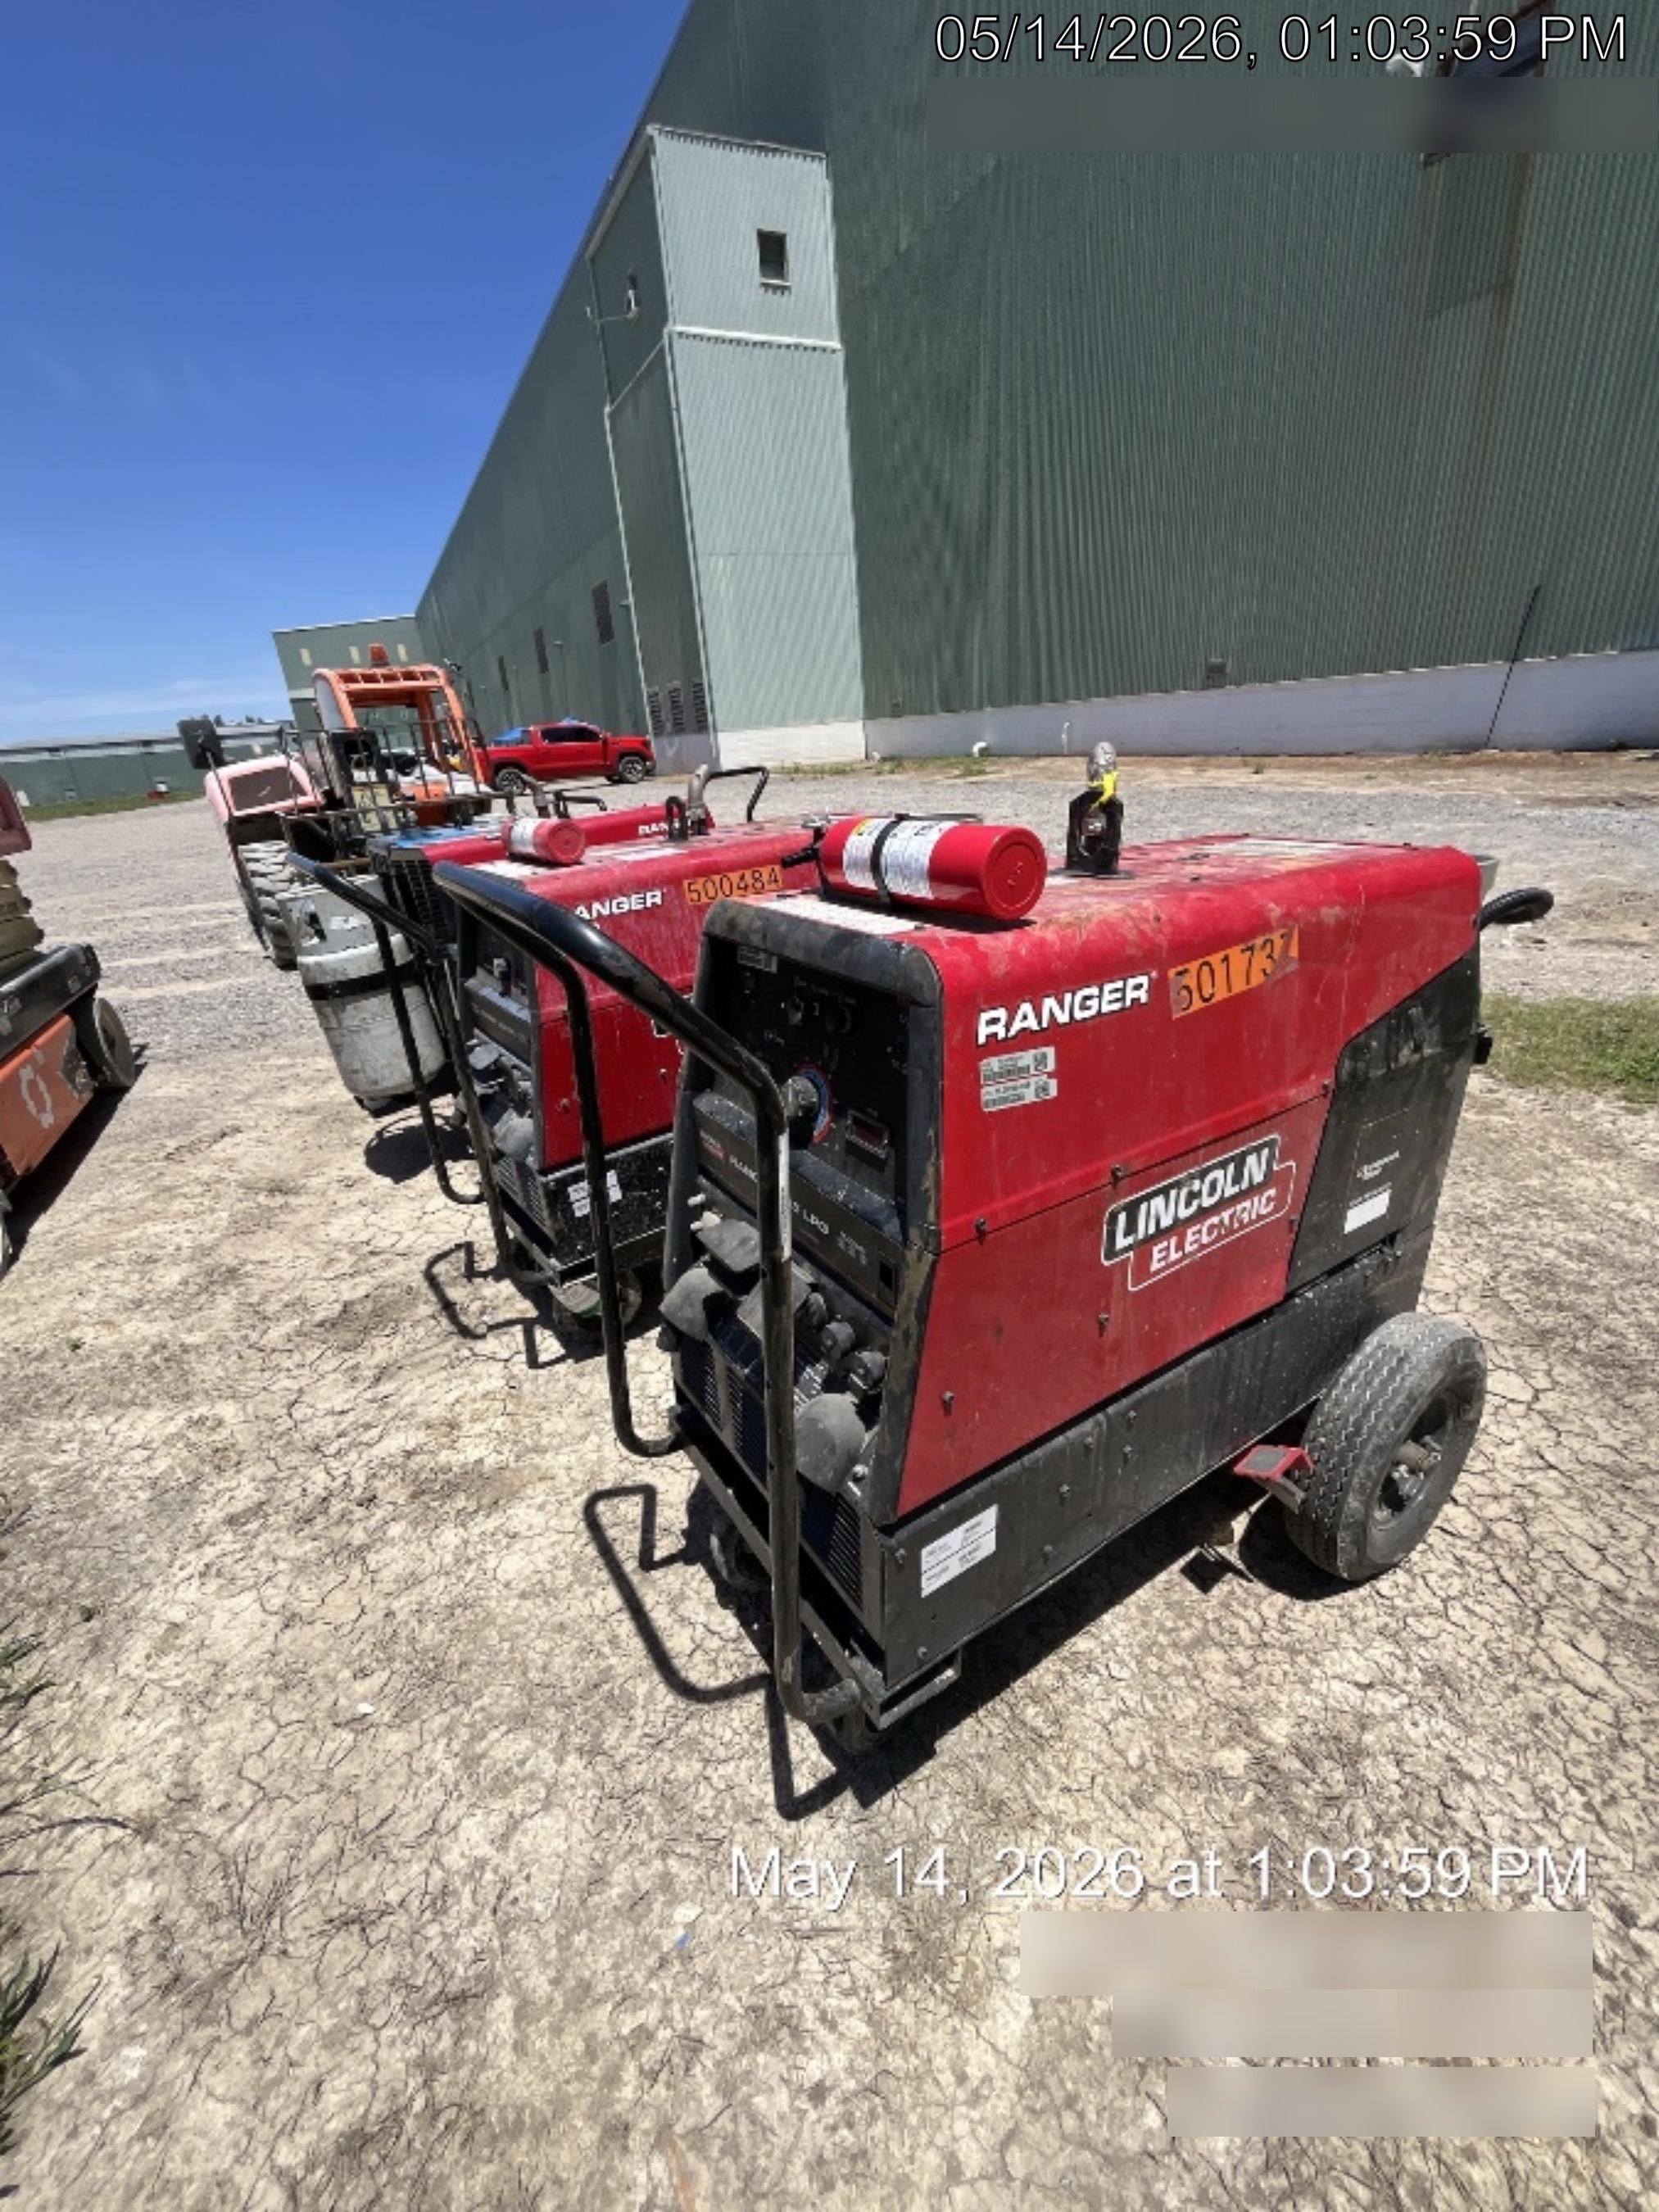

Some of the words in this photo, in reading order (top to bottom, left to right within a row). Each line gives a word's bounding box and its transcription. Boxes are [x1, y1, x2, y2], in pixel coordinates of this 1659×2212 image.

[574, 888, 664, 921] ANGER
[687, 868, 780, 903] 500484
[976, 972, 1151, 1047] RANGER
[1114, 1147, 1270, 1251] LINCOLN
[1149, 1188, 1277, 1272] ELECTRIC
